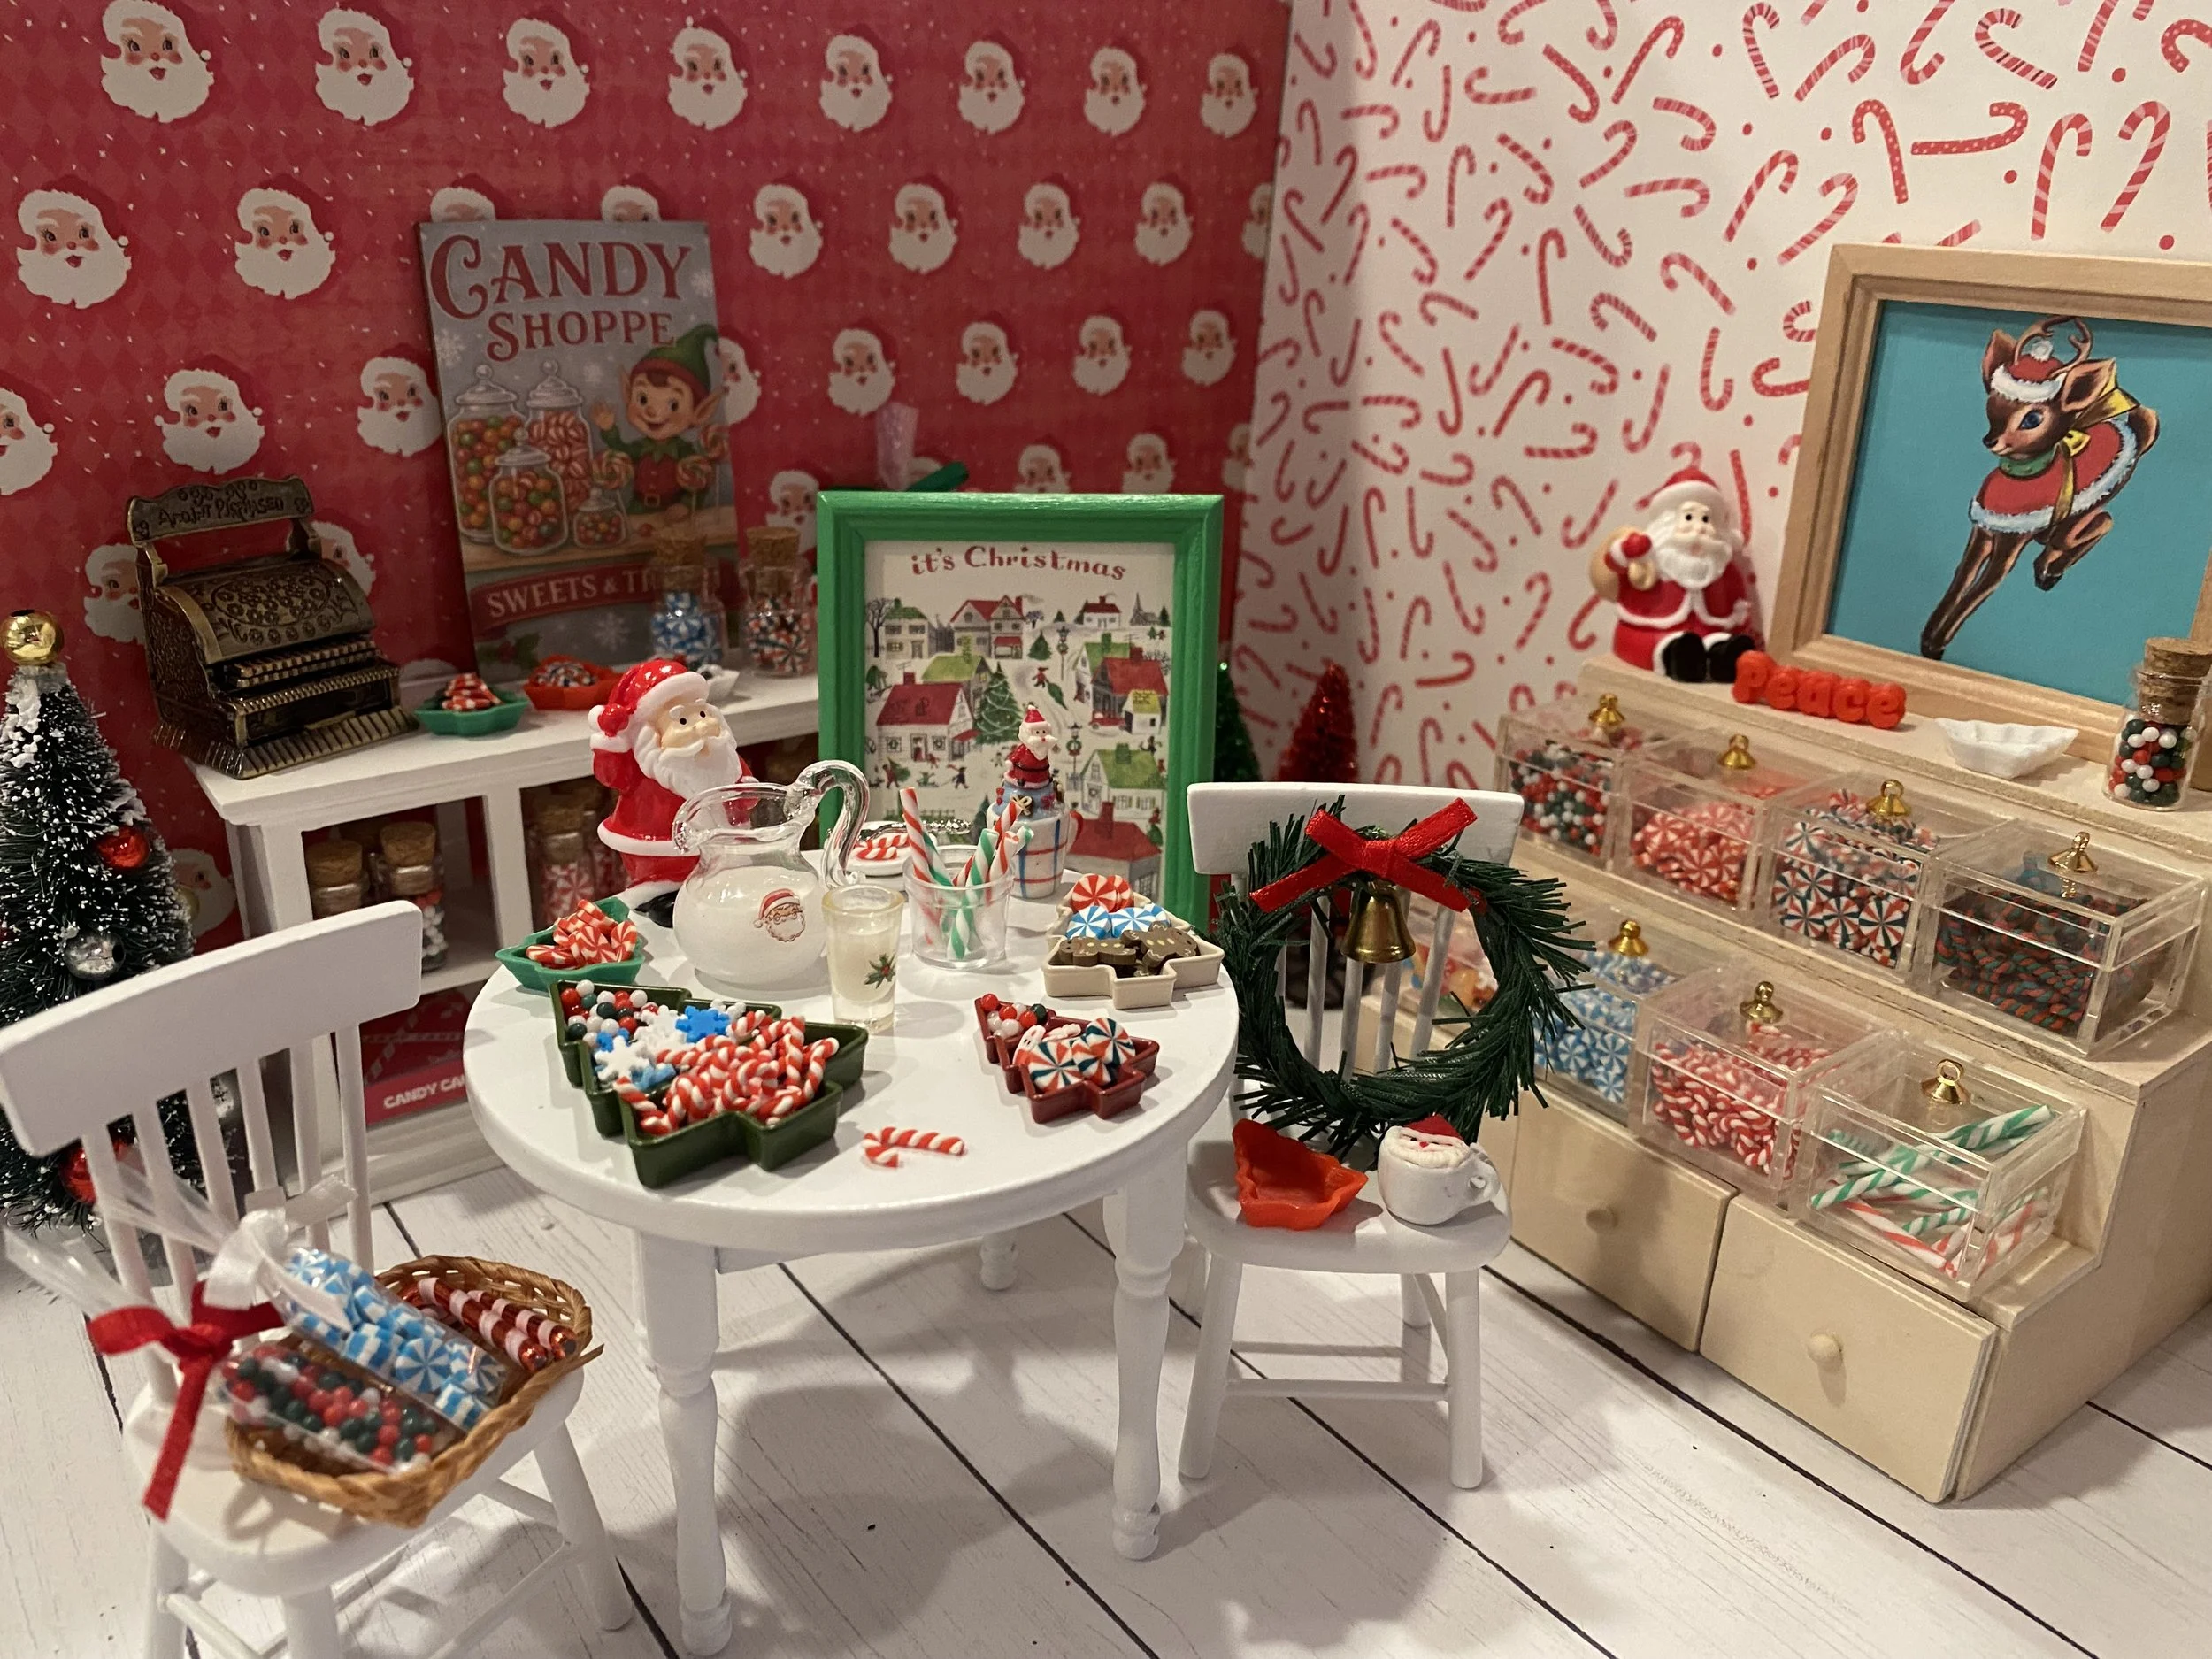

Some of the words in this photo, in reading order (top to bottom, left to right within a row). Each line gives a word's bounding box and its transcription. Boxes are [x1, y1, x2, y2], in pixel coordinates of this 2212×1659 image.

[430, 234, 692, 319] CANDY
[487, 310, 675, 362] SHOPPE
[910, 547, 955, 575] it's
[964, 544, 1126, 580] Christmas
[487, 573, 597, 618] SWEETS
[603, 577, 618, 593] &
[1732, 649, 1907, 729] Peace
[383, 1082, 437, 1109] CANDY
